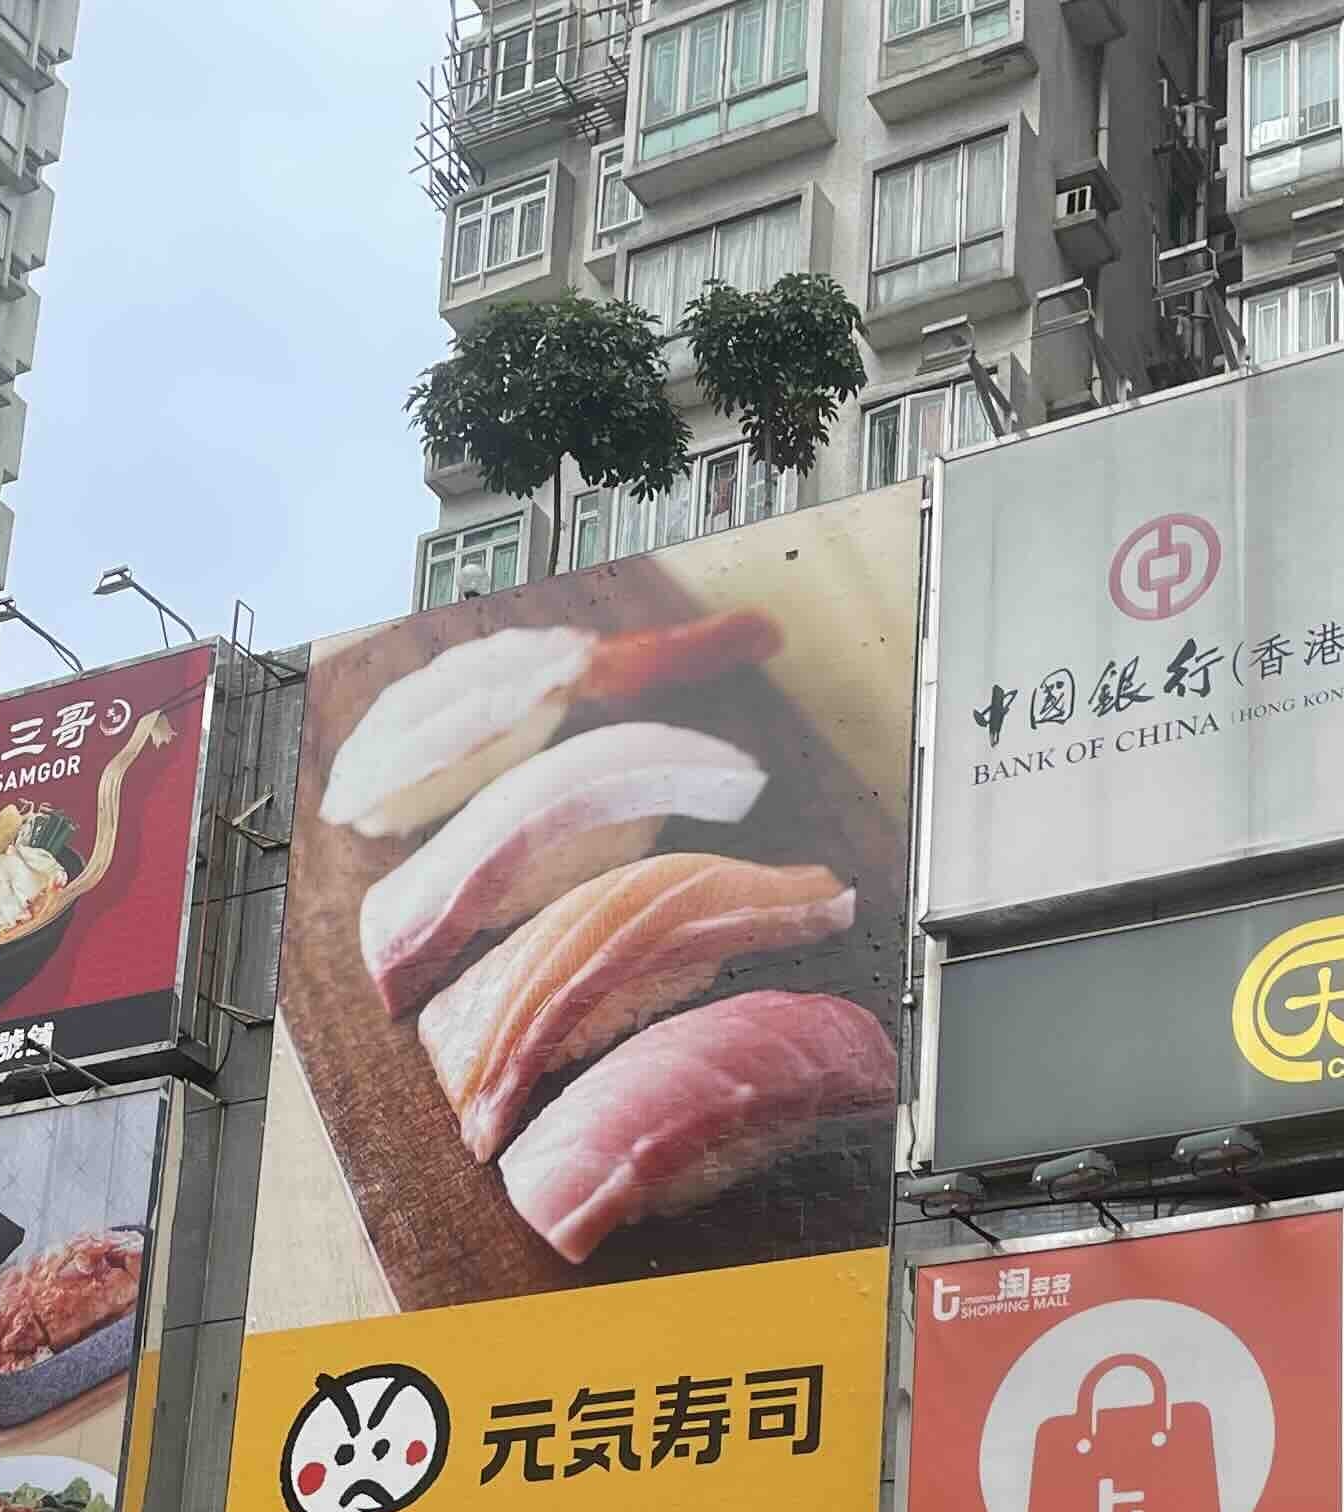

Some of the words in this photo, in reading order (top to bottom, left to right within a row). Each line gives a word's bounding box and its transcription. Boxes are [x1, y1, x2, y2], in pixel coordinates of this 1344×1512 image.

[972, 746, 1056, 787] BANK
[1065, 735, 1106, 766] OF
[1115, 712, 1221, 754] CHINA
[960, 1300, 1031, 1320] SHOPPING
[1033, 1295, 1071, 1311] MALL
[479, 1363, 824, 1487] 元気寿司
